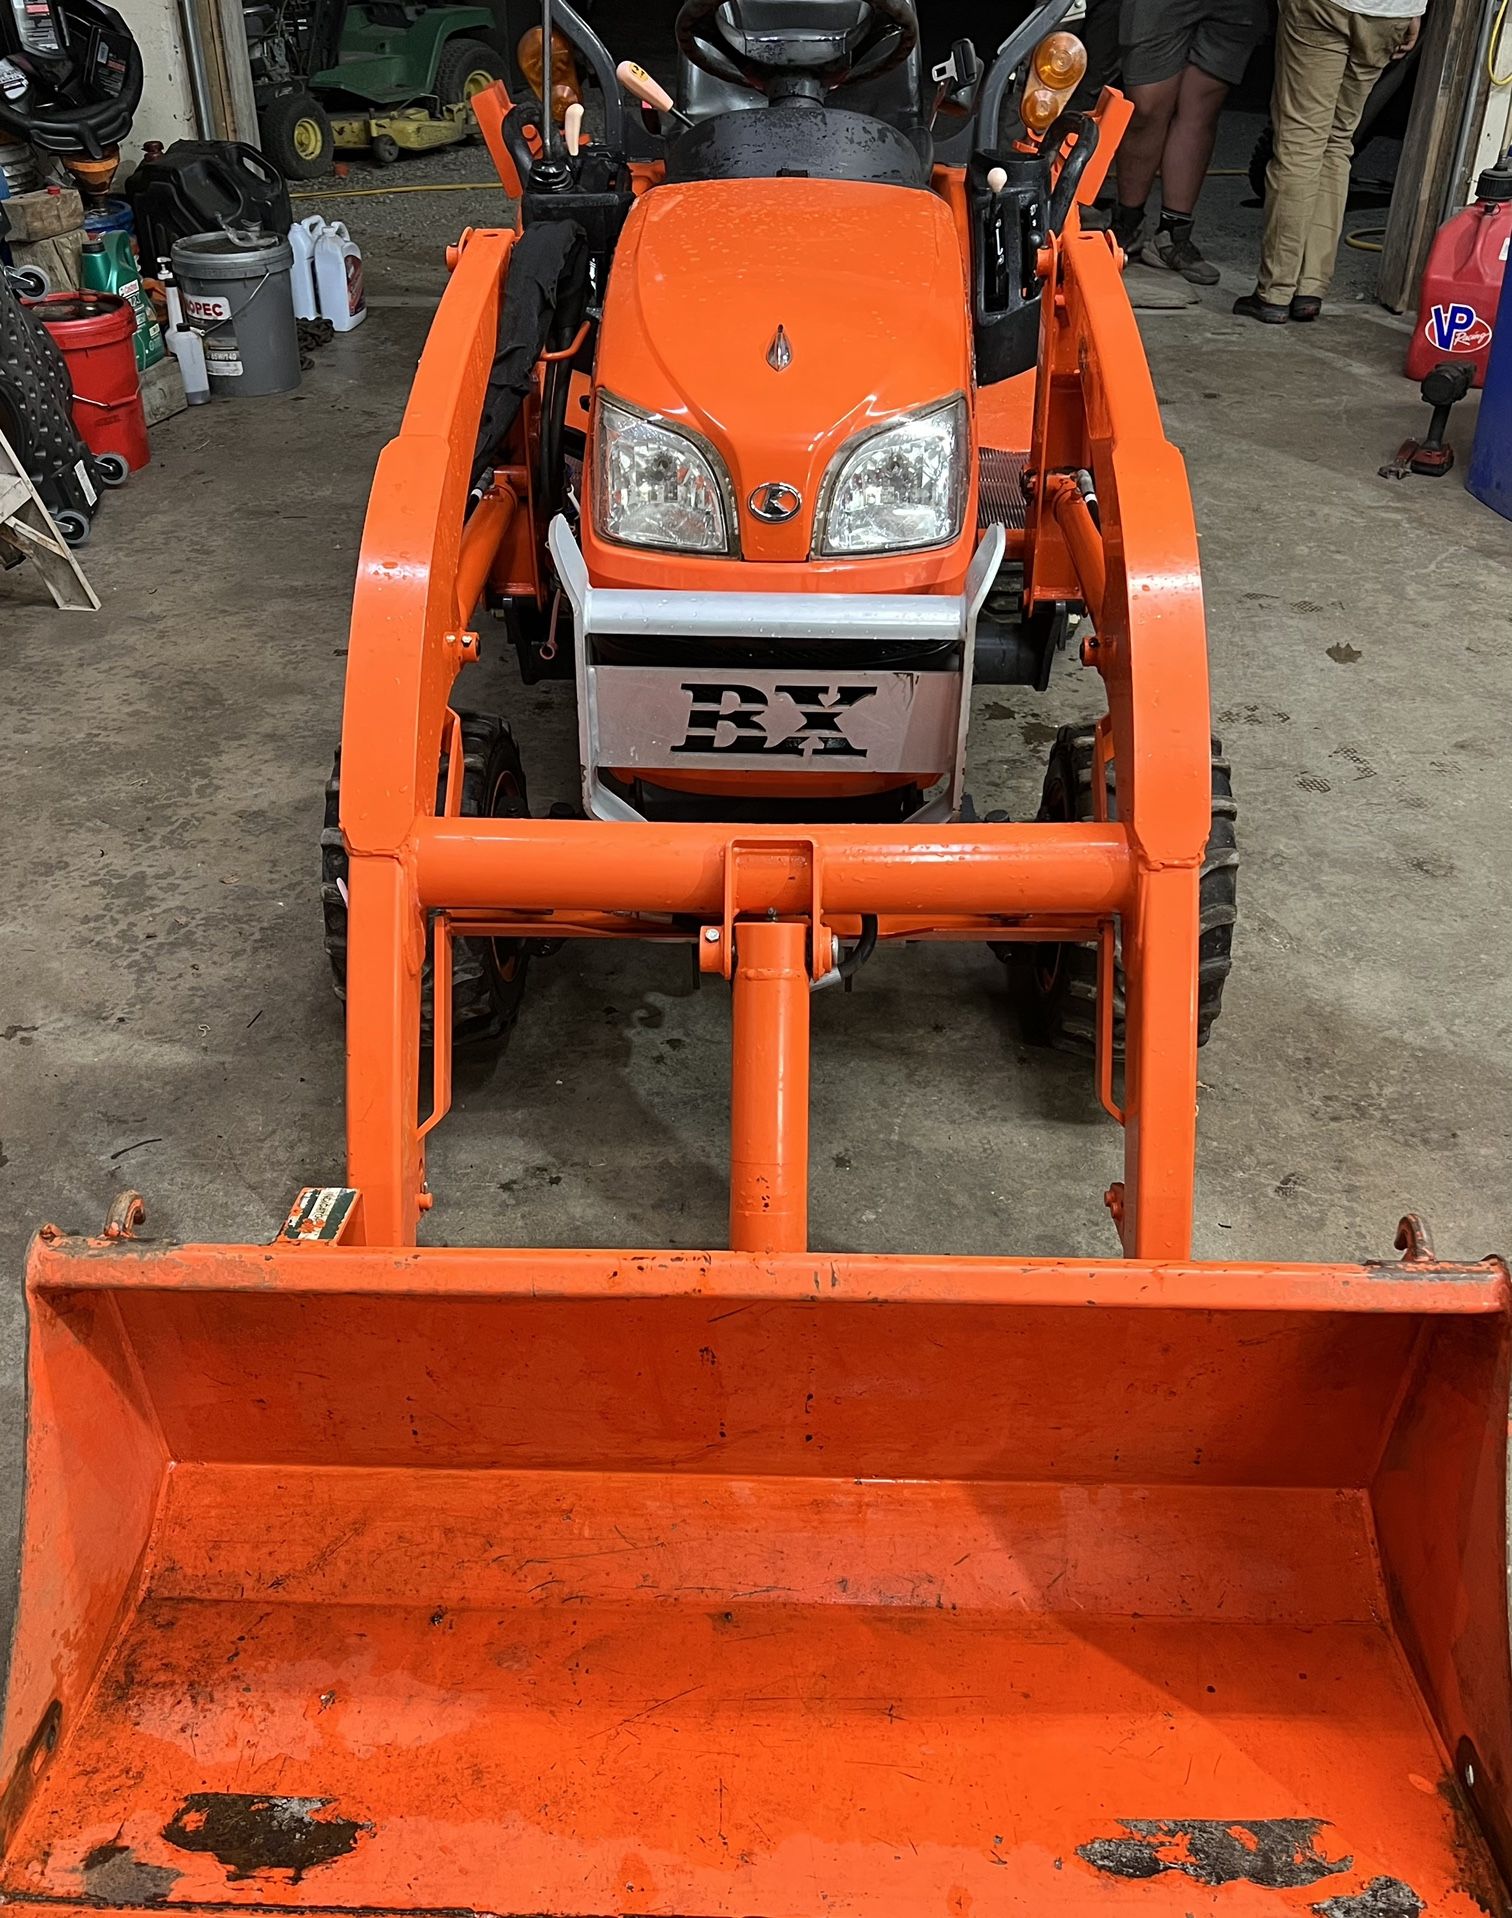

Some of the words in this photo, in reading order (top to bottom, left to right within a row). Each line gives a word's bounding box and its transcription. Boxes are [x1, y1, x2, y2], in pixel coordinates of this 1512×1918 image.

[1431, 303, 1476, 351] VP
[1453, 331, 1490, 346] Racing
[670, 683, 878, 757] BX
